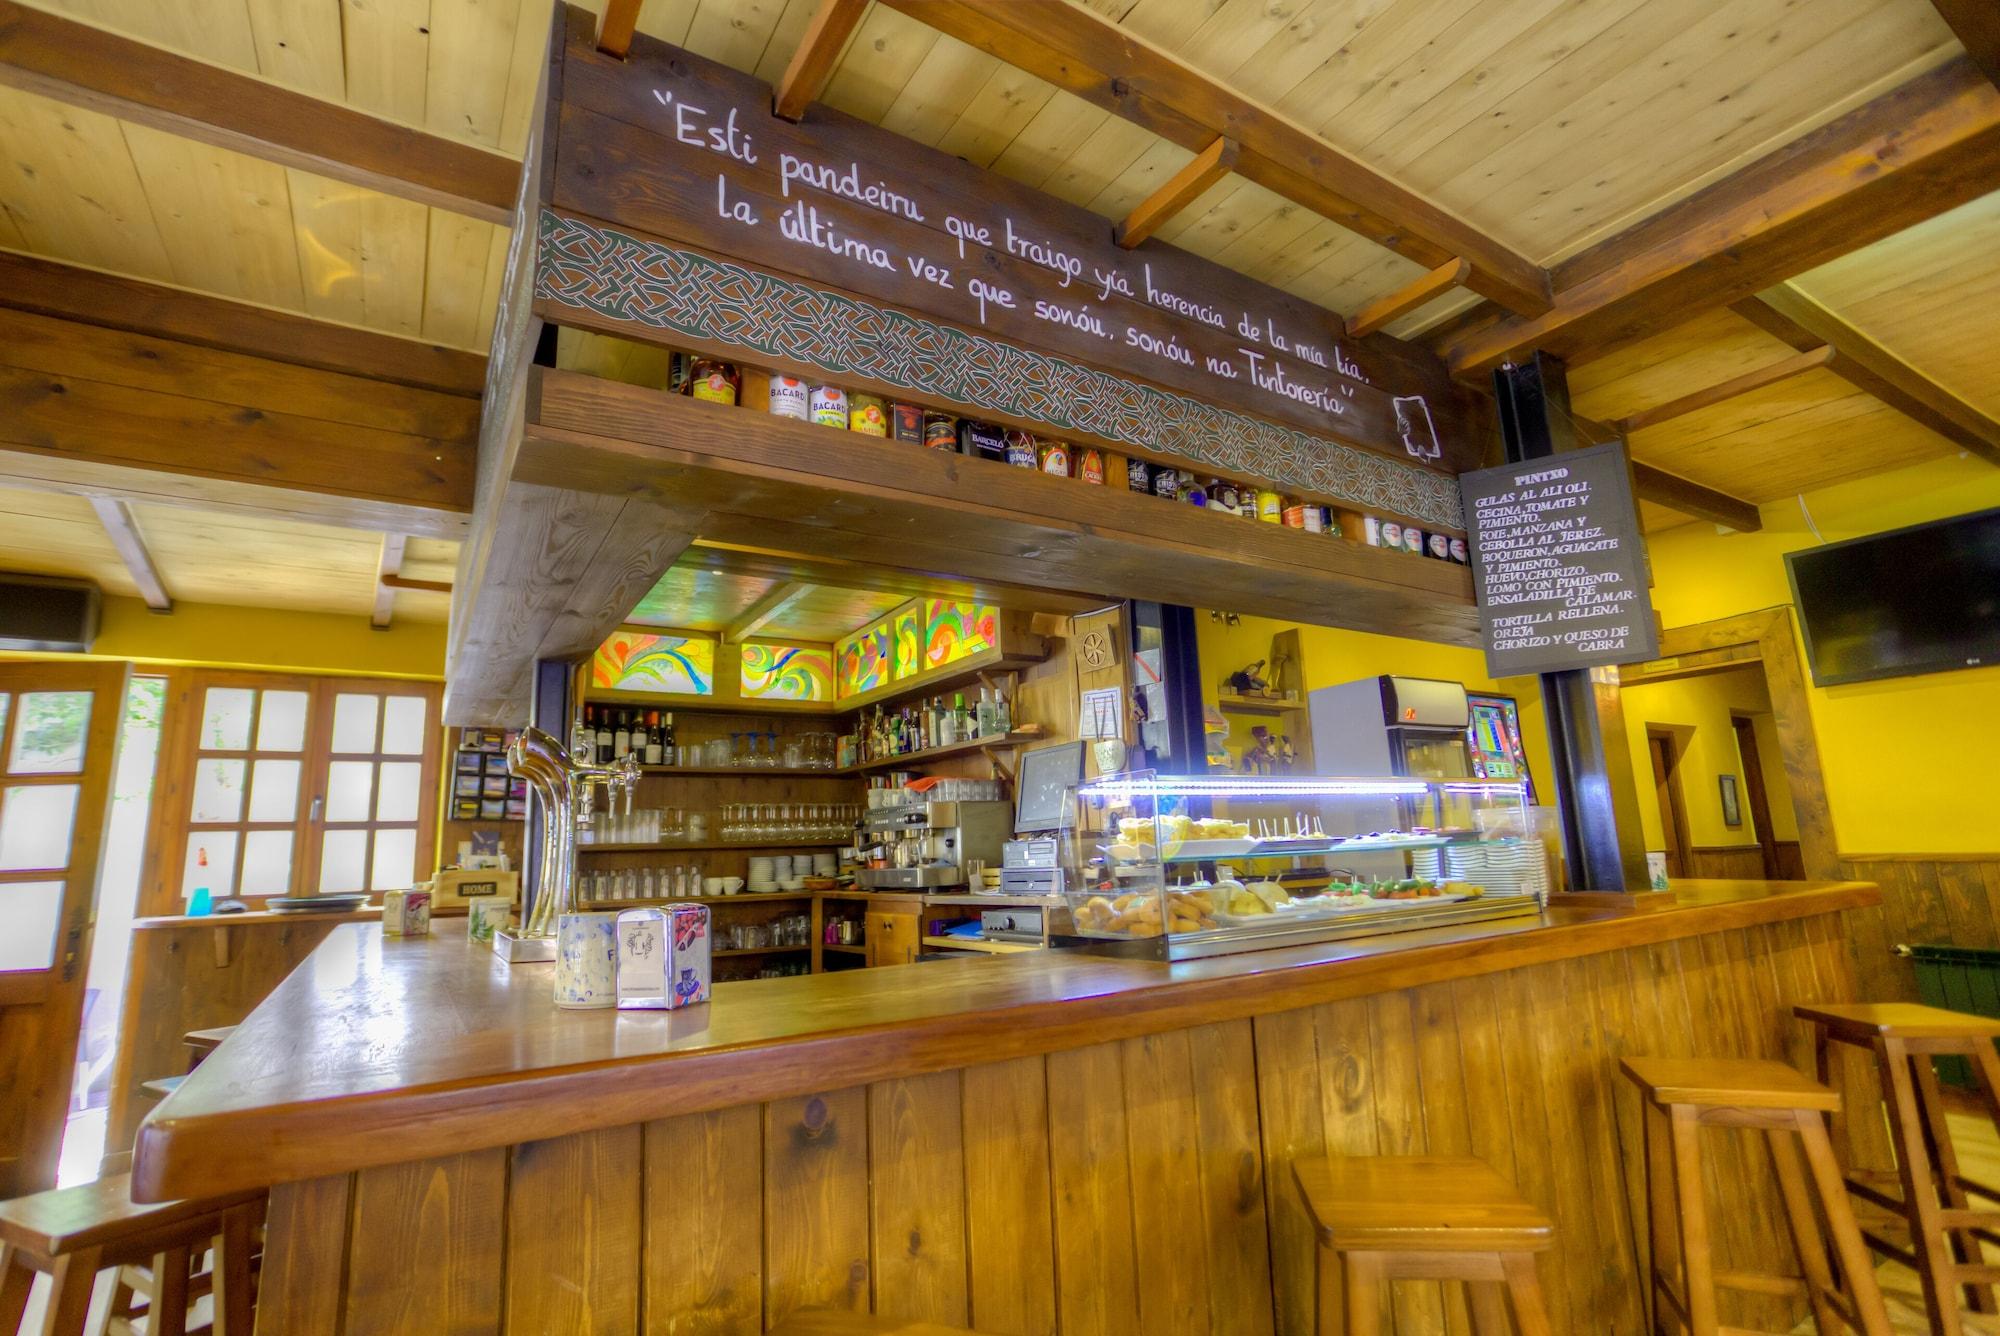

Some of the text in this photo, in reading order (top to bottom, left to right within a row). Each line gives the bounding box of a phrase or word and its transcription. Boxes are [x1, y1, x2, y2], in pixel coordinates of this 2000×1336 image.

[780, 152, 925, 222] pandeiru
[945, 214, 992, 259] que
[1006, 218, 1081, 288] traigo
[1144, 263, 1226, 329] herencia
[1238, 312, 1261, 342] de
[1267, 318, 1287, 353] la
[1296, 342, 1328, 368] mía
[780, 200, 897, 272] última
[907, 256, 955, 290] vez
[968, 276, 1017, 324] que
[1126, 326, 1195, 367] sonóu
[1205, 354, 1238, 380] na
[770, 388, 806, 401] BACARD
[813, 401, 847, 413] BACARD
[1475, 492, 1516, 508] GULAS
[1519, 489, 1538, 501] AL
[1539, 484, 1563, 499] ALI
[1580, 495, 1590, 506] Y
[1478, 513, 1541, 530] PIMIENTO.
[1576, 516, 1587, 527] Y
[1479, 536, 1535, 552] CEBOLLA
[1537, 532, 1556, 545] AL
[1559, 526, 1605, 543] JEREZ.
[1485, 564, 1495, 574] Y
[1486, 571, 1623, 595] LOMO CON PIMIENTO.
[1487, 585, 1597, 607] ENSALADILLA DE
[1492, 604, 1624, 628] TORTILLA RELLENA.
[1493, 626, 1534, 639] OREJA
[1493, 626, 1630, 651] CHORIZO Y QUESO DE
[1577, 638, 1625, 652] CABRA
